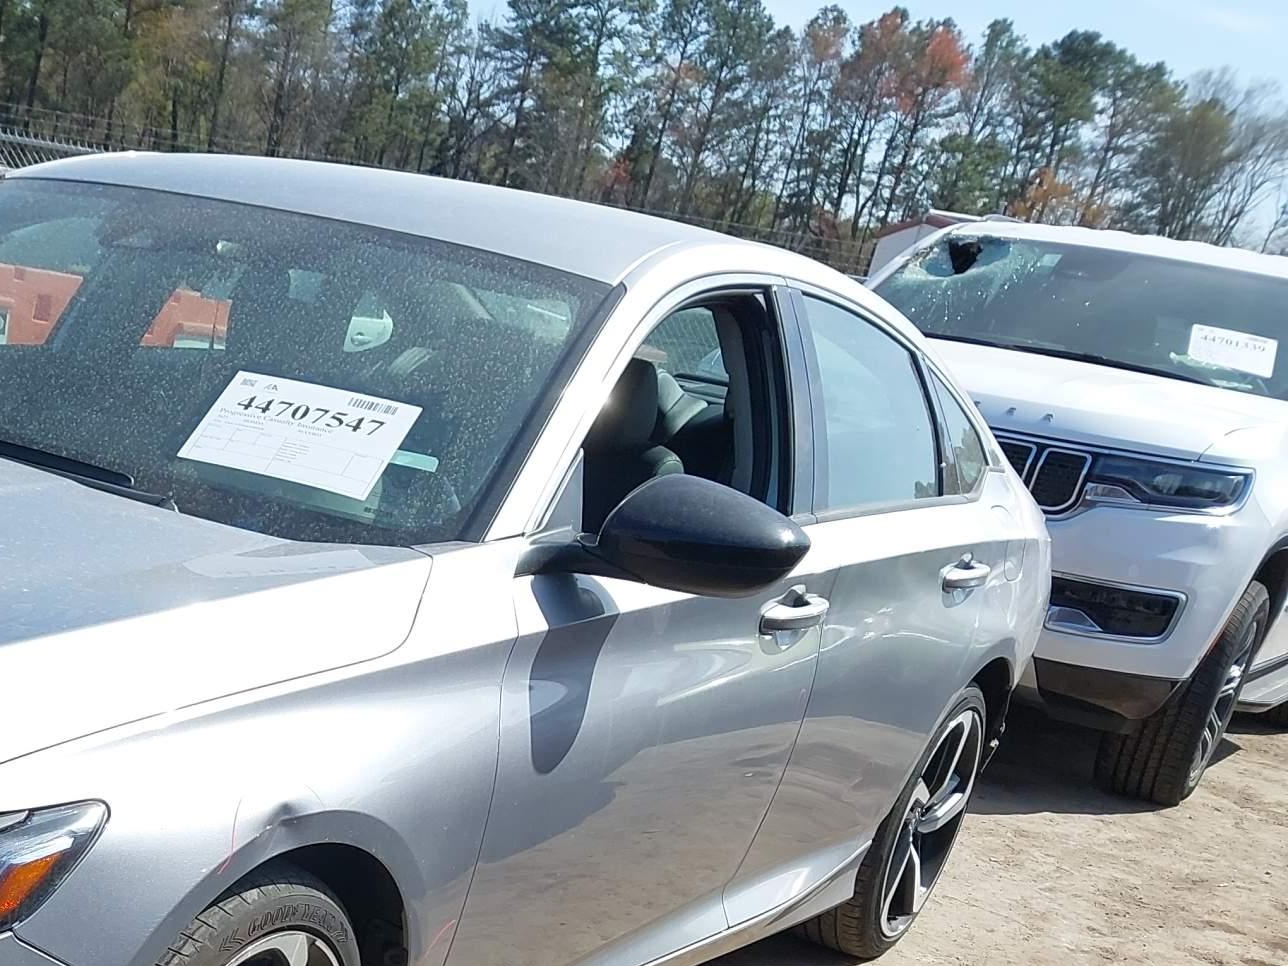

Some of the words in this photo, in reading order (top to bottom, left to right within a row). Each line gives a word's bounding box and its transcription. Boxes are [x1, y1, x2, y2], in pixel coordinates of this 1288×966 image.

[237, 395, 386, 436] 44707547
[264, 414, 295, 427] Casualty
[297, 421, 334, 434] Insurance
